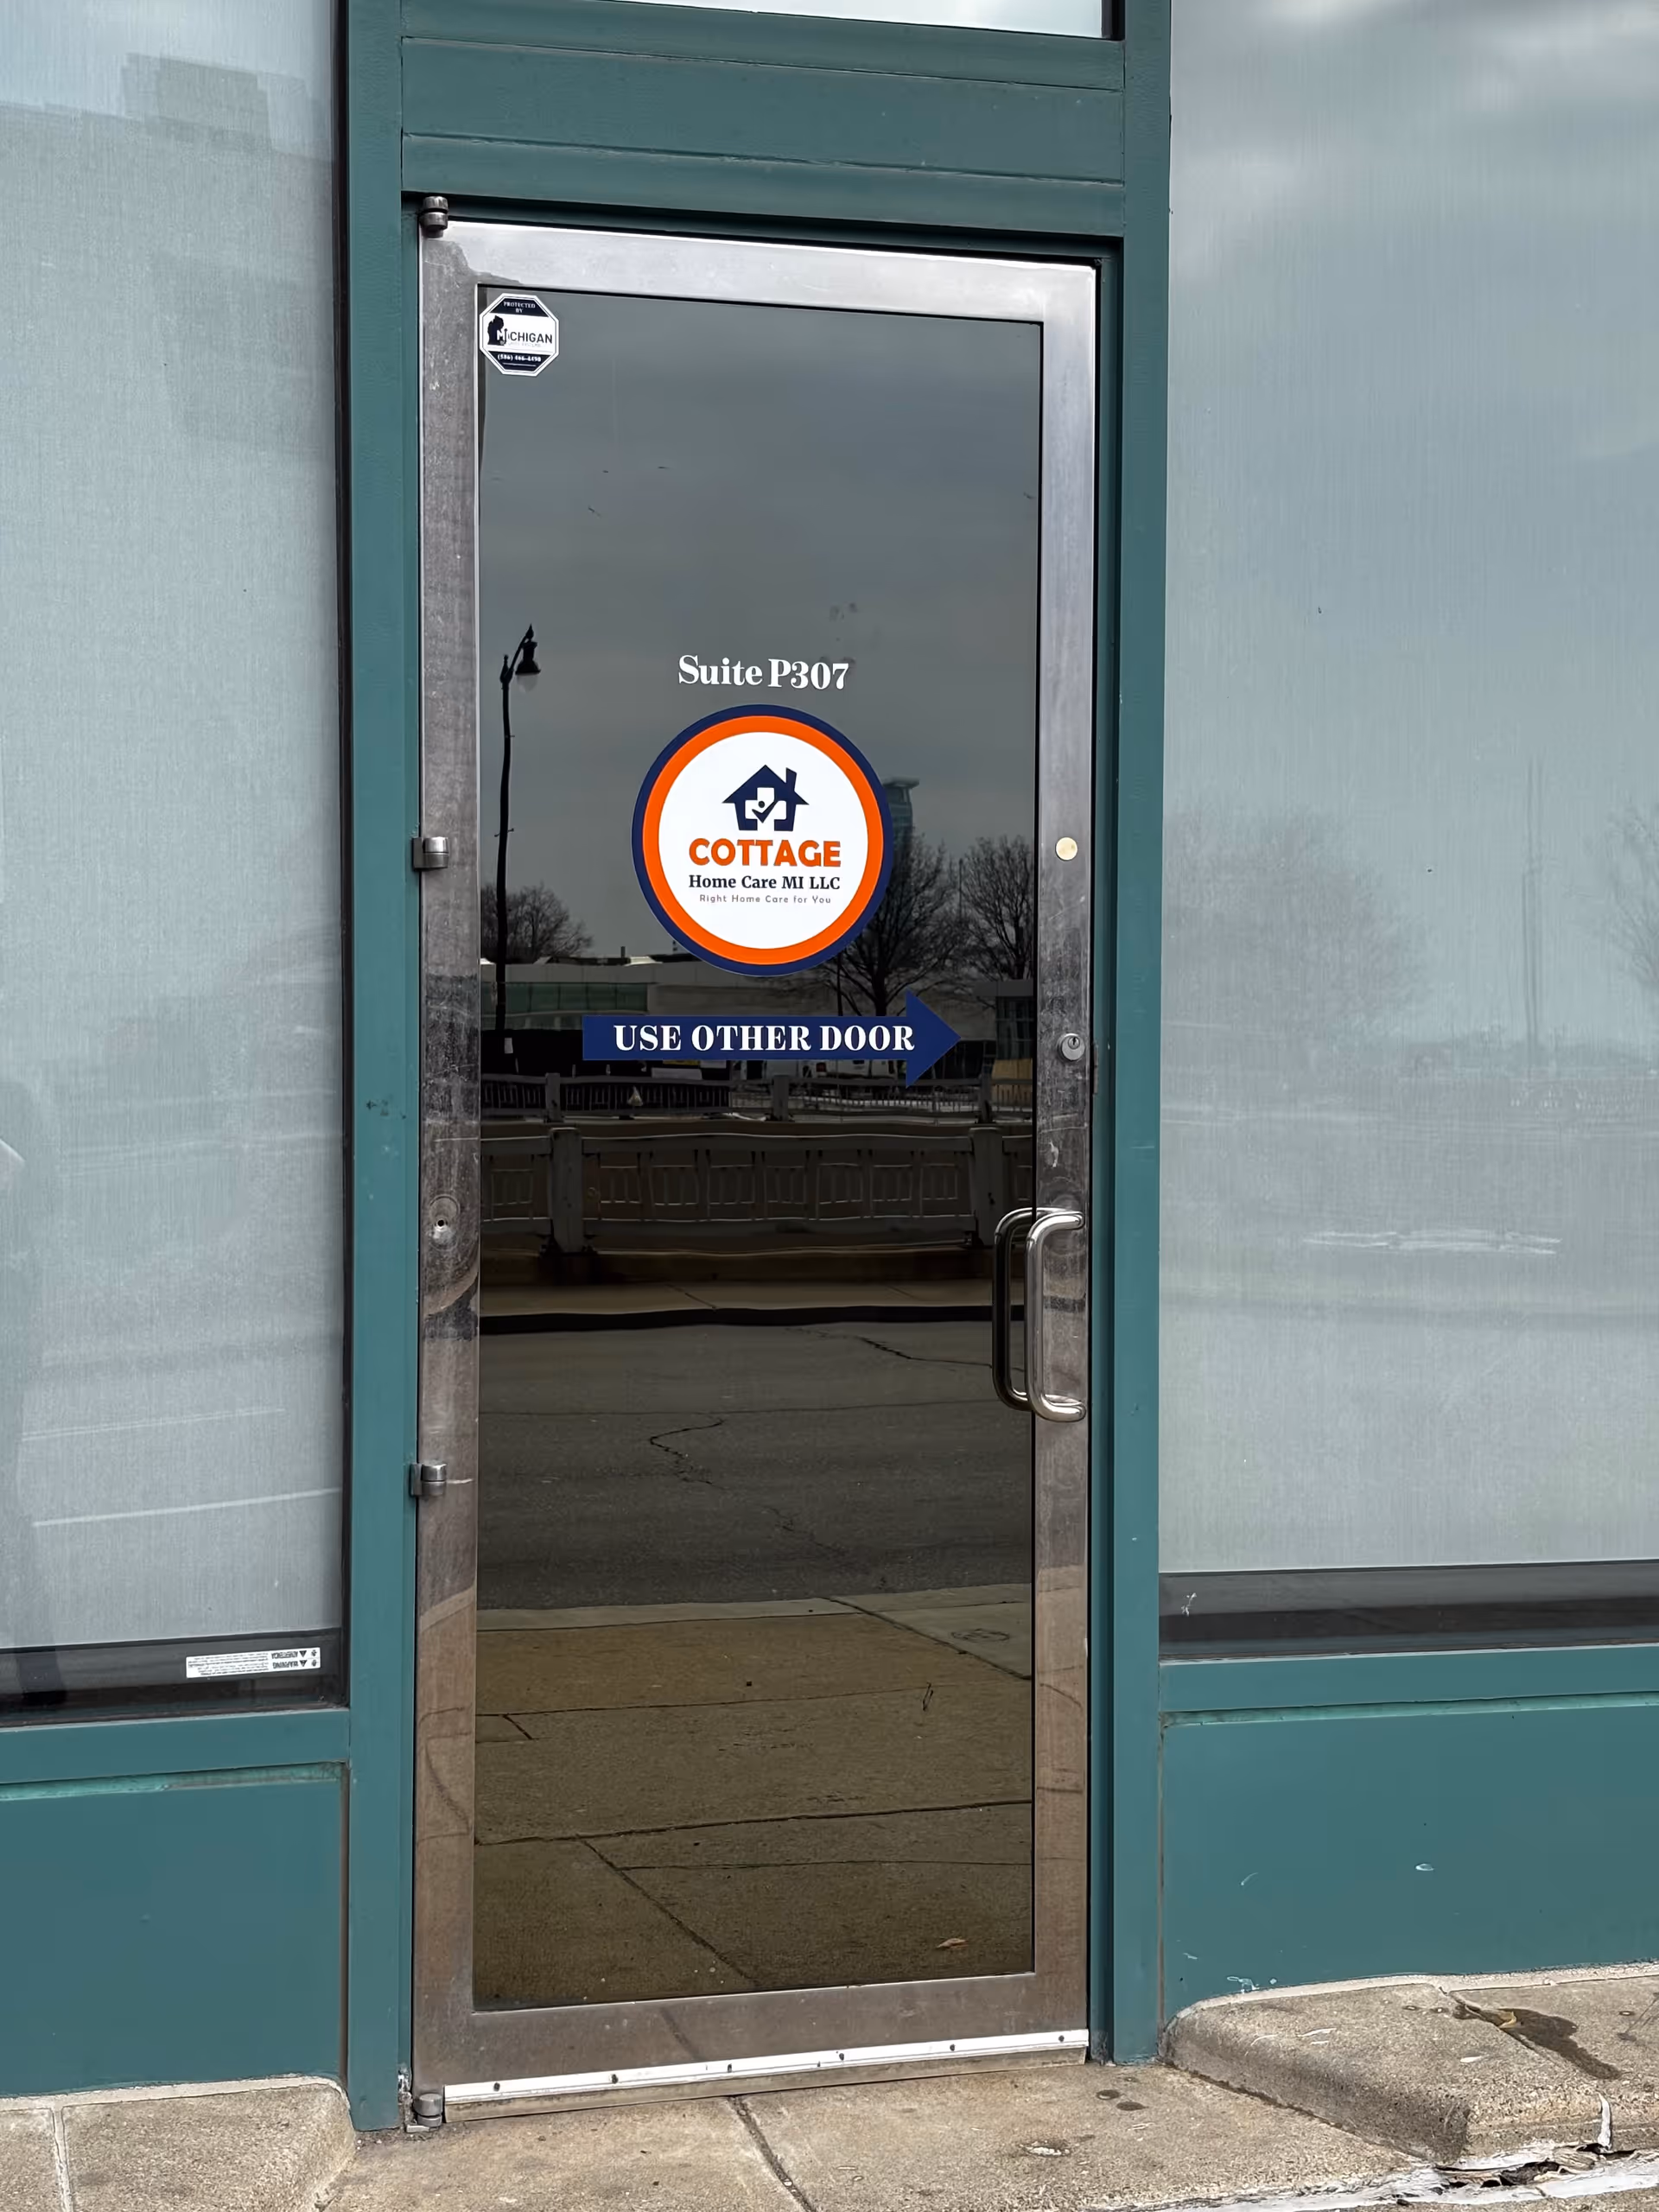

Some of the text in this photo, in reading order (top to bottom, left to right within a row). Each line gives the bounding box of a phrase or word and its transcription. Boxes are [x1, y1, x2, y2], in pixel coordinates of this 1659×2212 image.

[678, 654, 849, 690] Suite P307
[689, 838, 841, 868] COTTAGE
[689, 874, 841, 890] Home Care MI LLC
[699, 894, 727, 904] Right
[732, 894, 760, 903] Home
[793, 895, 807, 904] for
[811, 895, 831, 904] You
[613, 1025, 915, 1052] USE OTHER DOOR
